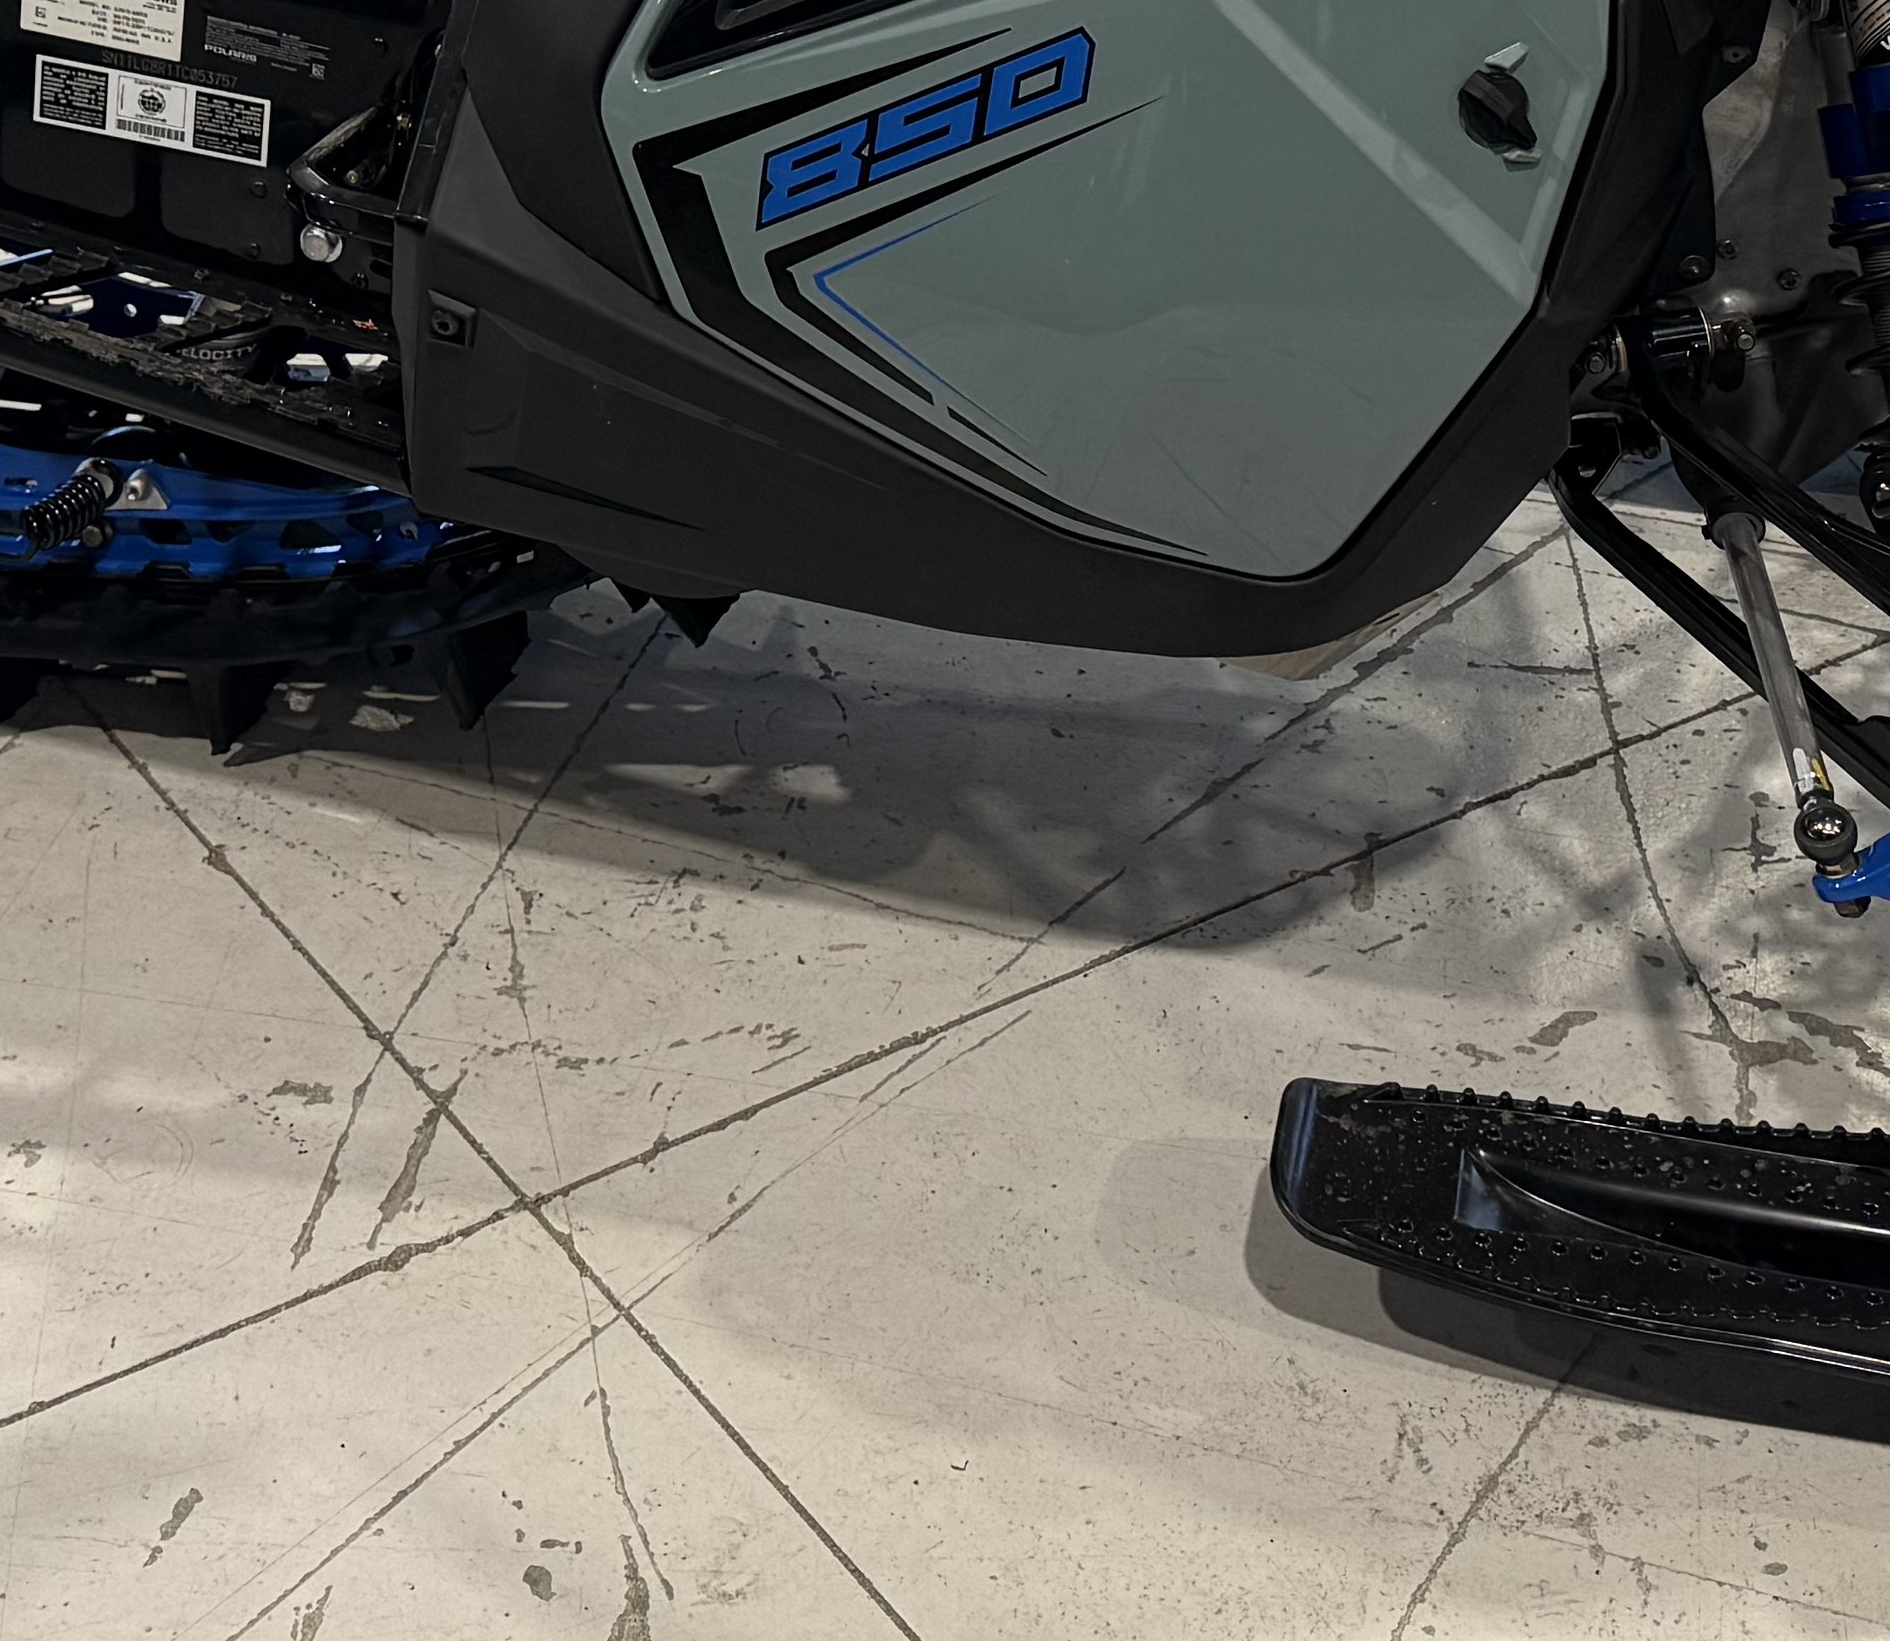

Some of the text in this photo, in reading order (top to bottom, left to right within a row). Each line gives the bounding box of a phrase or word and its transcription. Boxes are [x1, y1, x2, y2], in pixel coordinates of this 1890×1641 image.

[204, 43, 258, 63] POLARIS
[756, 25, 1096, 232] 850
[176, 343, 258, 360] ELOCITY
